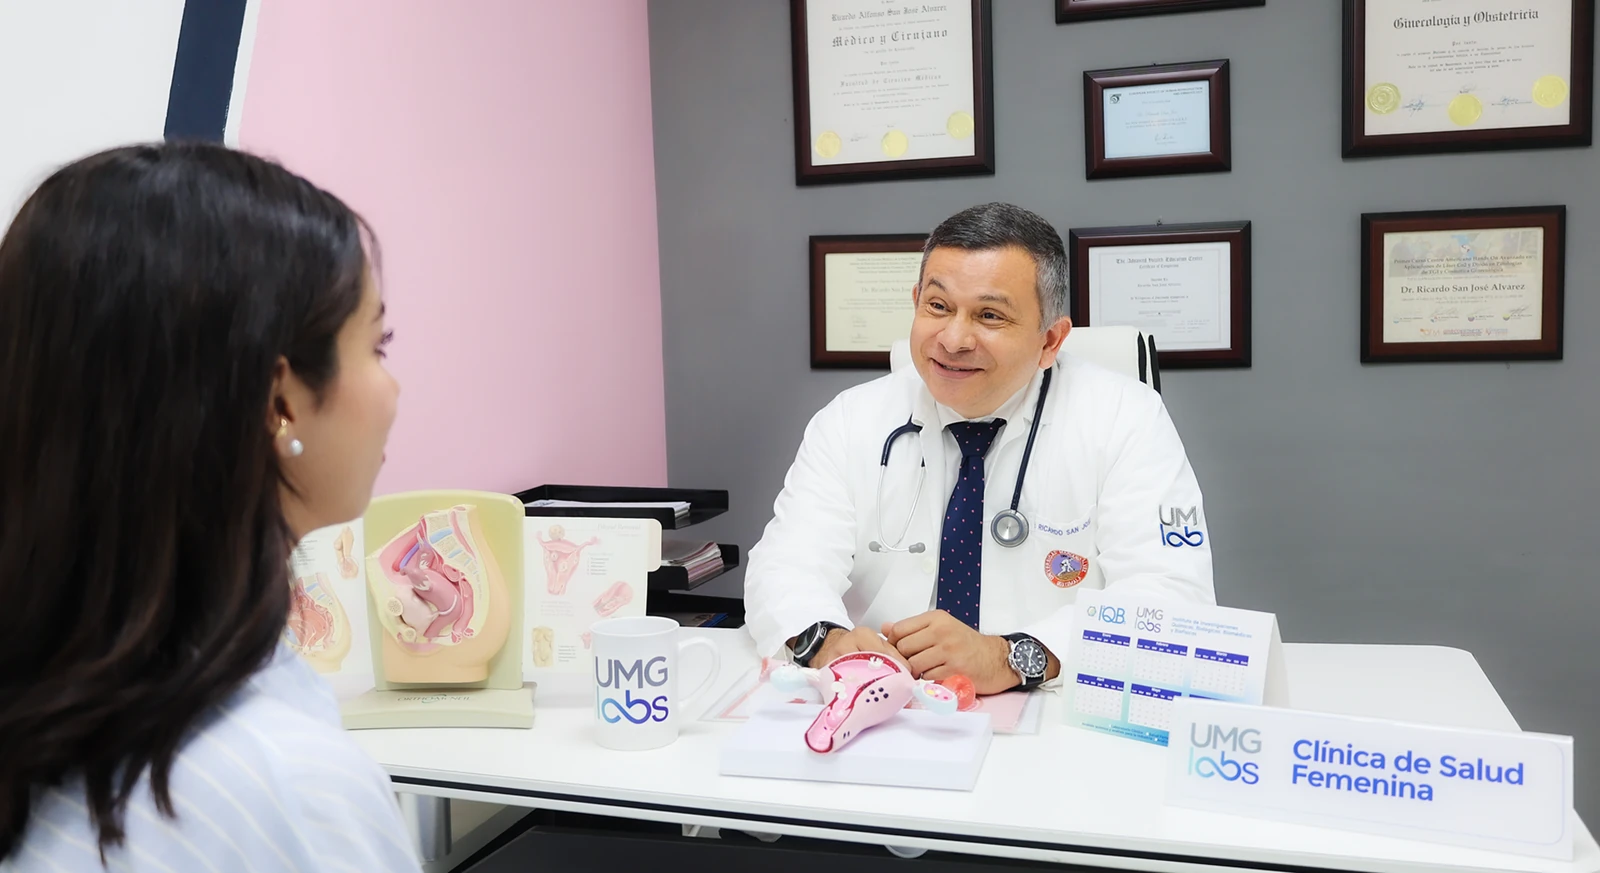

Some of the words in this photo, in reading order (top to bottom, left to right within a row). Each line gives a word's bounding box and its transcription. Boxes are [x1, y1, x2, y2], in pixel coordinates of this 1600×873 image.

[1393, 14, 1460, 29] Ginecología
[1463, 16, 1470, 27] y
[1474, 9, 1539, 24] Obstetricia
[832, 34, 875, 47] Médico
[880, 35, 886, 45] y
[891, 30, 948, 43] Cirujano
[1401, 286, 1414, 294] Dr.
[1418, 284, 1450, 293] Ricardo
[1452, 284, 1469, 292] San
[1471, 283, 1489, 293] José
[1491, 282, 1525, 291] Alvarez
[1159, 505, 1198, 527] UM
[1038, 524, 1063, 536] RICARDO
[1066, 526, 1079, 536] SAN
[1160, 524, 1204, 547] lab
[1136, 607, 1163, 620] UMG
[1134, 617, 1161, 633] labs
[595, 656, 668, 689] UMG
[596, 685, 669, 725] labs
[1190, 722, 1263, 754] UMG
[1188, 747, 1260, 785] labs
[1293, 739, 1386, 770] Clínica
[1394, 751, 1431, 775] de
[1439, 755, 1525, 786] Salud
[1292, 764, 1434, 801] Femenina
